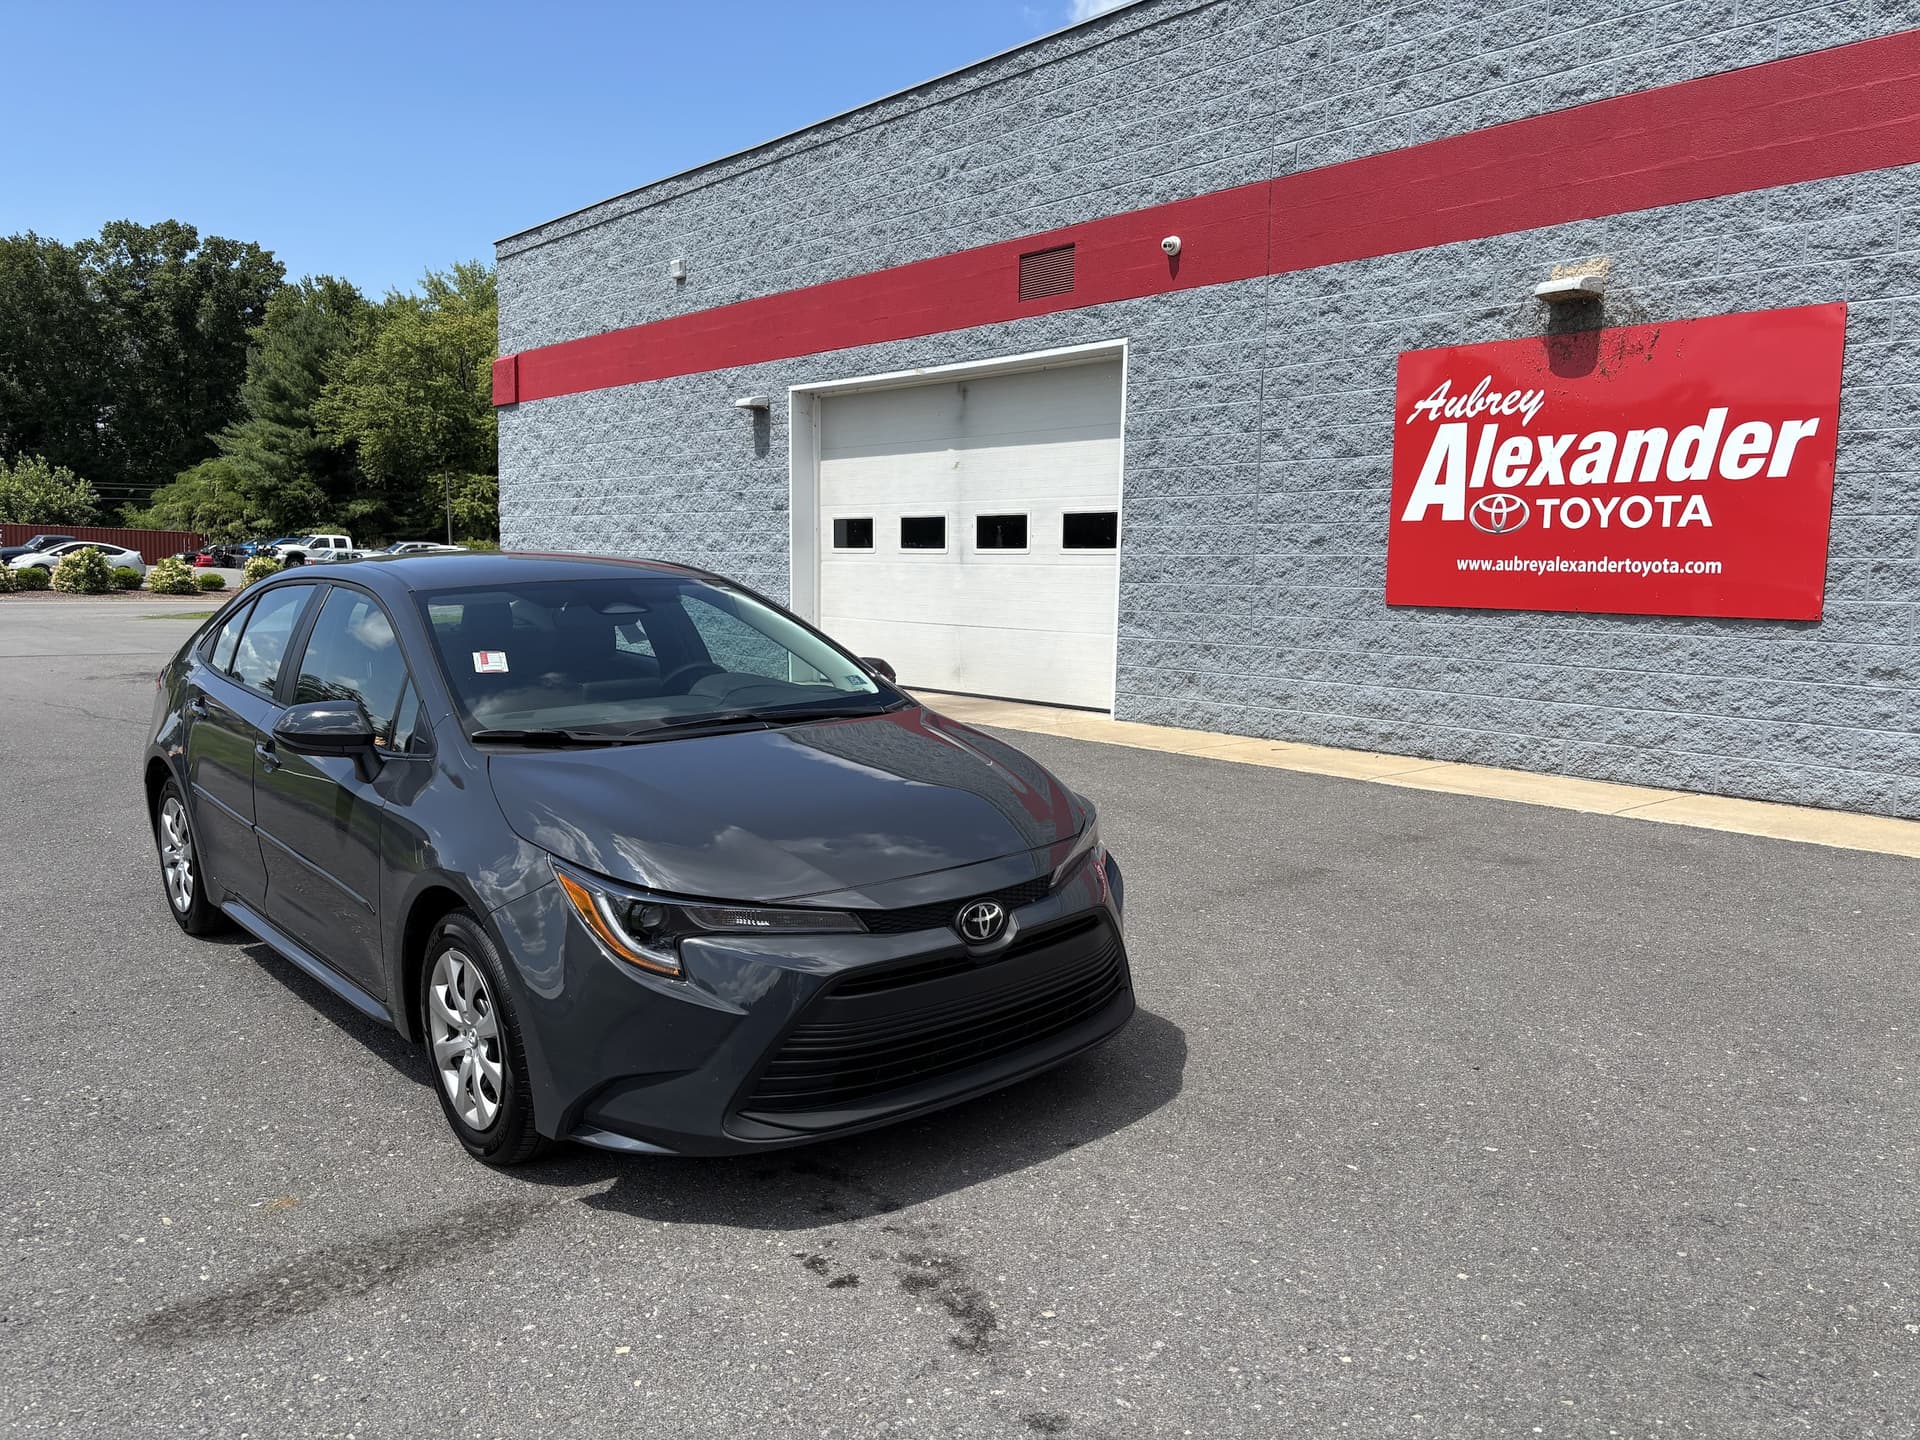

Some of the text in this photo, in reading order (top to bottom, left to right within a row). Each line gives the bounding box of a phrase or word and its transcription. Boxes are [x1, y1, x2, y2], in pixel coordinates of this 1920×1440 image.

[1406, 375, 1545, 426] Aubrey
[1401, 407, 1820, 522] Alexander
[1536, 494, 1713, 529] TOYOTA
[1456, 555, 1722, 577] www.aubreyalexandertoyota.com
